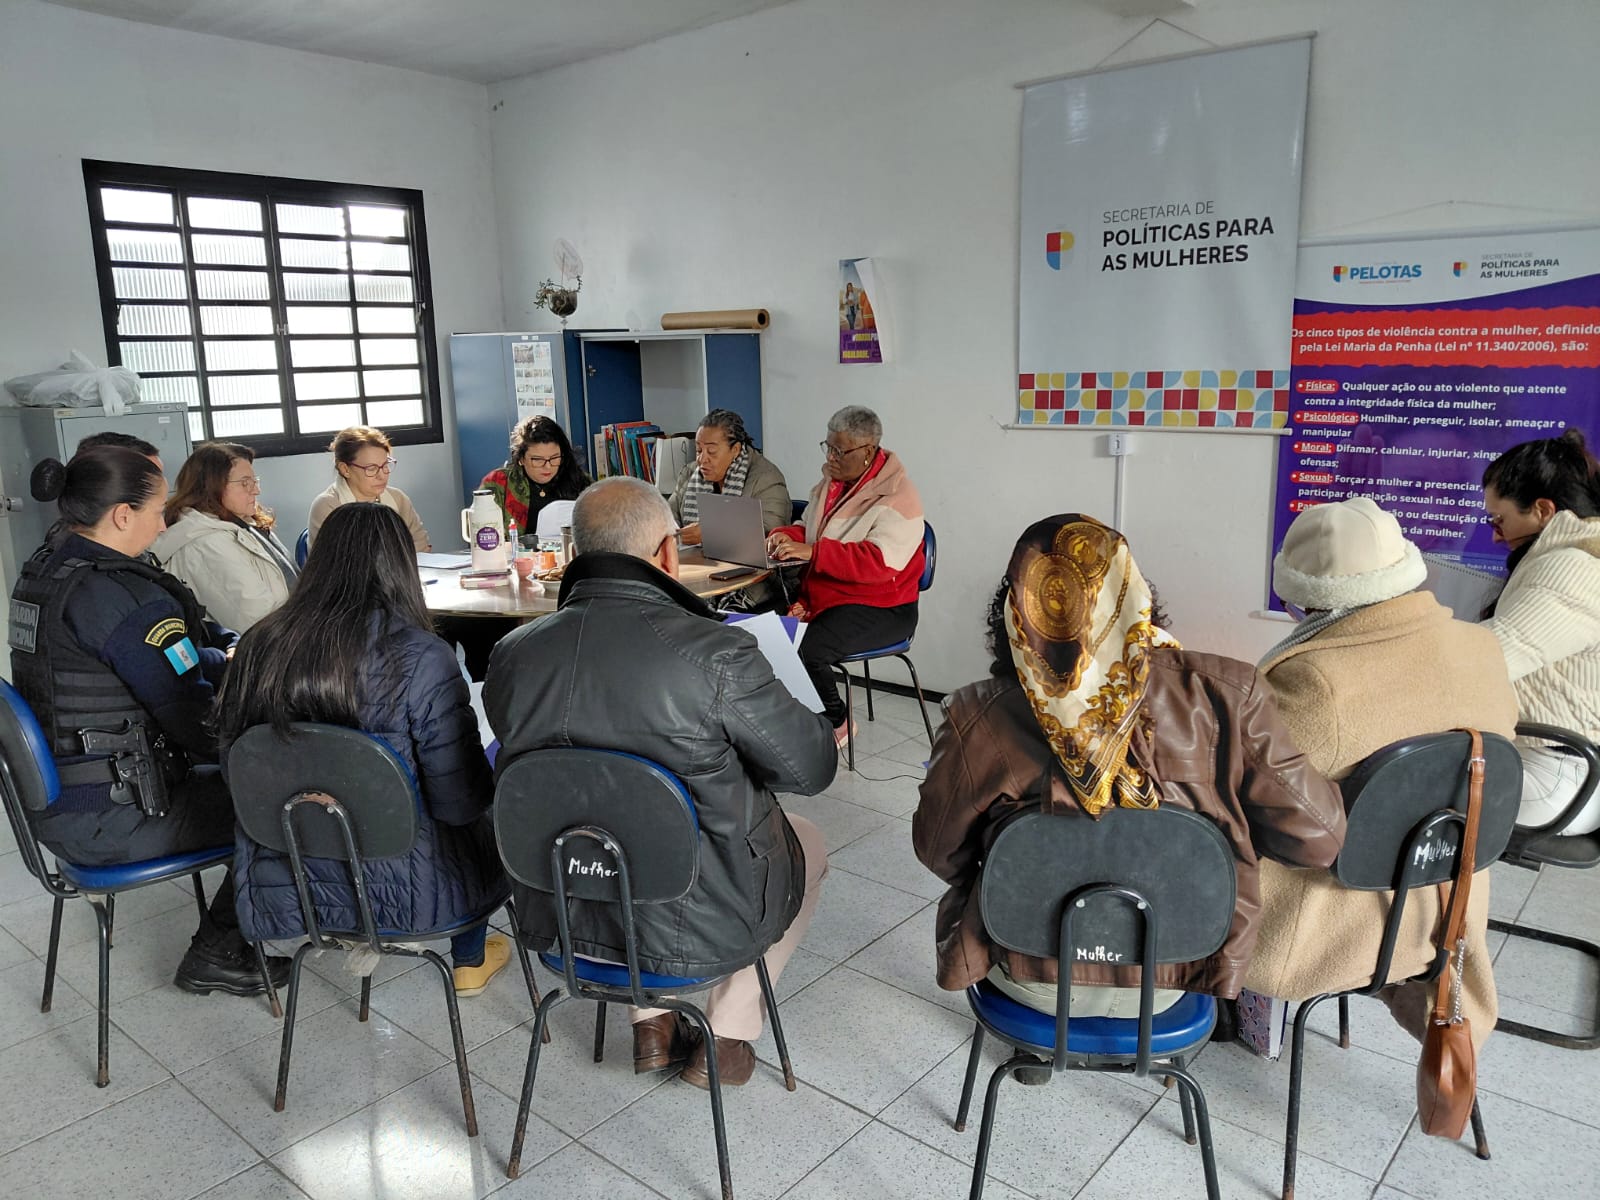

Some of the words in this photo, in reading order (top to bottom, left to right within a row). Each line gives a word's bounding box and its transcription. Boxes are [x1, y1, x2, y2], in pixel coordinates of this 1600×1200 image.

[1103, 203, 1191, 224] SECRETARIA
[1195, 200, 1215, 215] DE
[1103, 222, 1210, 247] POLÍTICAS
[1216, 216, 1274, 238] PARA
[1101, 253, 1127, 271] AS
[1133, 244, 1249, 269] MULHERES
[1481, 259, 1531, 269] POLÍTICAS
[1533, 258, 1560, 267] PARA
[1350, 264, 1422, 280] PELOTAS
[1480, 271, 1492, 279] AS
[1495, 269, 1548, 278] MULHERES
[1292, 328, 1304, 337] Os
[1306, 328, 1334, 337] cinco
[1336, 327, 1364, 339] tipos
[1366, 327, 1381, 337] de
[1383, 326, 1435, 337] violência
[1438, 327, 1478, 336] contra
[1481, 327, 1489, 335] a
[1492, 325, 1542, 337] mulher,
[1300, 342, 1322, 354] pela
[1325, 342, 1341, 352] Lei
[1344, 342, 1376, 352] Maria
[1378, 342, 1392, 352] da
[1395, 342, 1432, 352] Penha
[1434, 341, 1456, 353] (Lei
[1476, 341, 1557, 353] 11.340/2006),
[1561, 340, 1589, 351] são:
[1305, 381, 1336, 391] Física:
[1342, 382, 1389, 392] Qualquer
[1391, 382, 1416, 393] ação
[1434, 384, 1453, 392] ato
[1455, 383, 1500, 393] violento
[1503, 385, 1525, 395] que
[1527, 385, 1567, 394] atente
[1304, 398, 1336, 406] contra
[1346, 397, 1405, 409] integridade
[1407, 398, 1434, 408] física
[1437, 400, 1450, 409] da
[1453, 400, 1497, 410] mulher;
[1303, 412, 1359, 424] Psicológica:
[1360, 414, 1411, 425] Humilhar,
[1413, 416, 1466, 428] perseguir,
[1469, 417, 1502, 428] isolar,
[1505, 418, 1555, 430] ameaçar
[1558, 420, 1566, 428] e
[1302, 428, 1352, 438] manipular
[1336, 444, 1378, 455] Difamar,
[1381, 446, 1425, 457] caluniar,
[1428, 448, 1470, 459] injuriar,
[1300, 458, 1339, 468] ofensas;
[1299, 473, 1333, 483] Sexual:
[1335, 475, 1366, 486] Forçar
[1376, 478, 1413, 487] mulher
[1424, 481, 1484, 493] presenciar,
[1298, 488, 1345, 499] participar
[1346, 490, 1359, 498] de
[1362, 492, 1398, 503] relação
[1400, 495, 1433, 504] sexual
[1435, 496, 1456, 506] não
[1406, 511, 1419, 519] ou
[1421, 511, 1477, 524] destruição
[1410, 526, 1423, 535] da
[1425, 527, 1466, 539] mulher.
